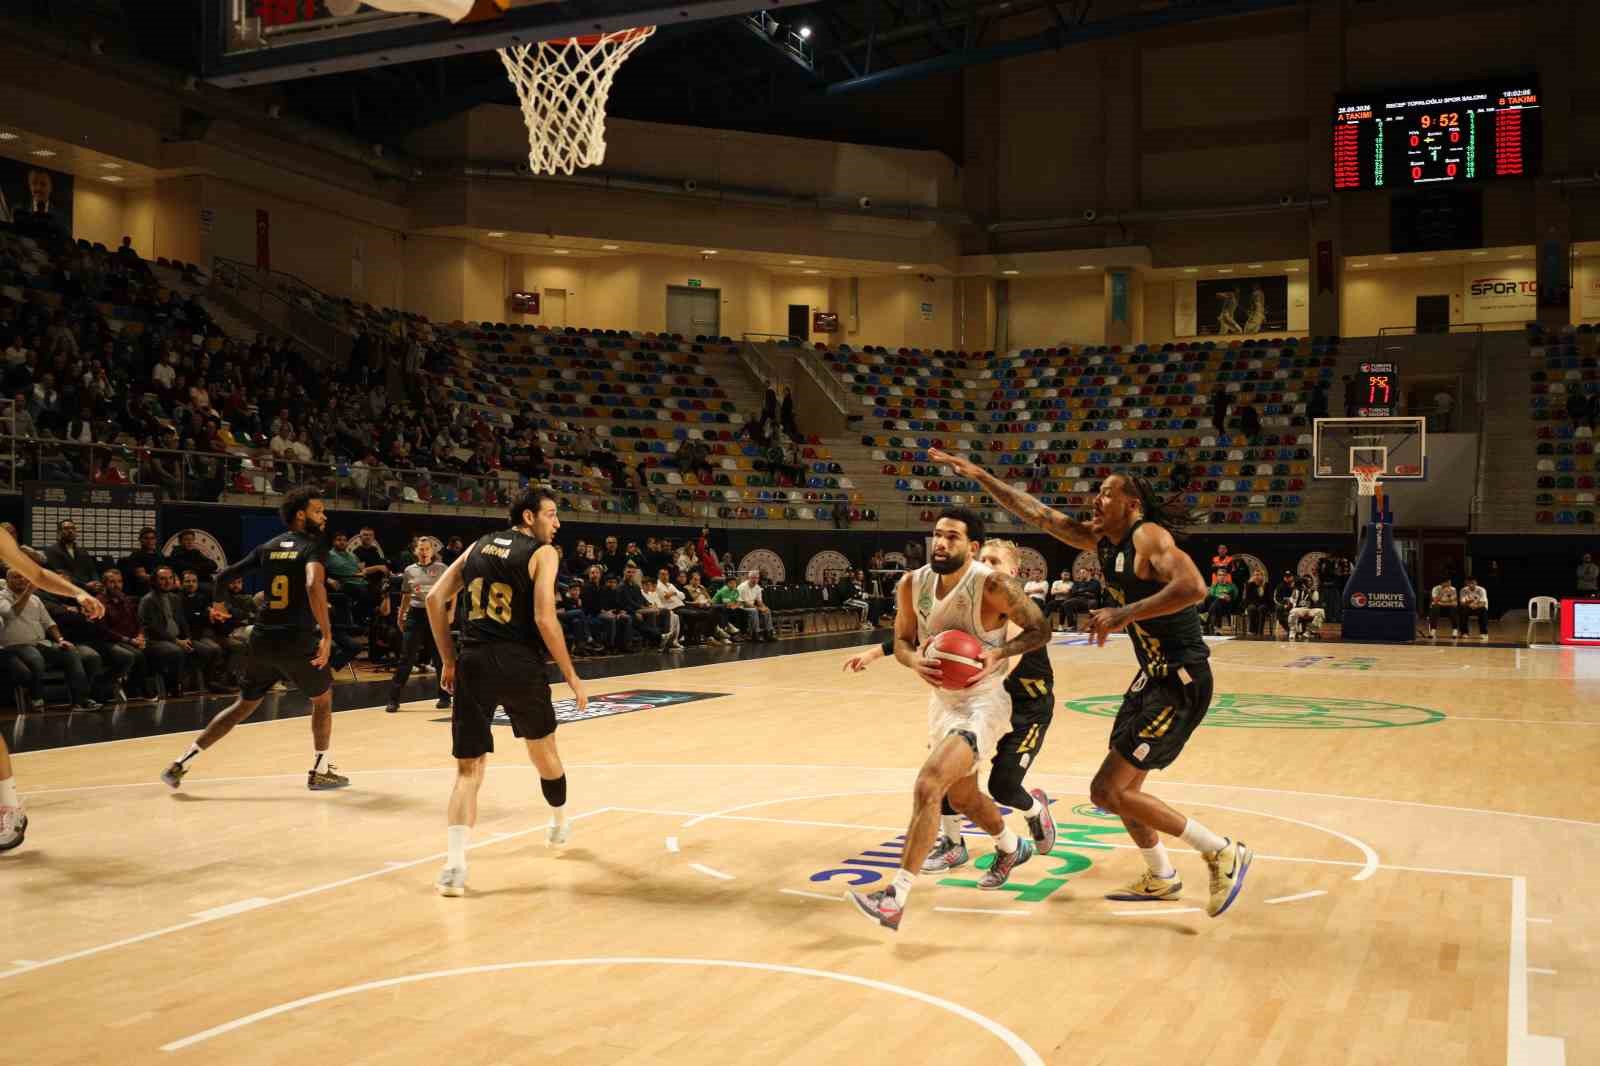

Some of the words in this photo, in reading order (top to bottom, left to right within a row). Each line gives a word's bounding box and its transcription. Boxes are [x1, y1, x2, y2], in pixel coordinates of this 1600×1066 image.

[1409, 135, 1419, 147] 0
[1450, 132, 1460, 143] 0
[1430, 150, 1437, 161] 1
[1411, 166, 1422, 179] 0
[1446, 164, 1457, 177] 0
[270, 575, 289, 609] 9
